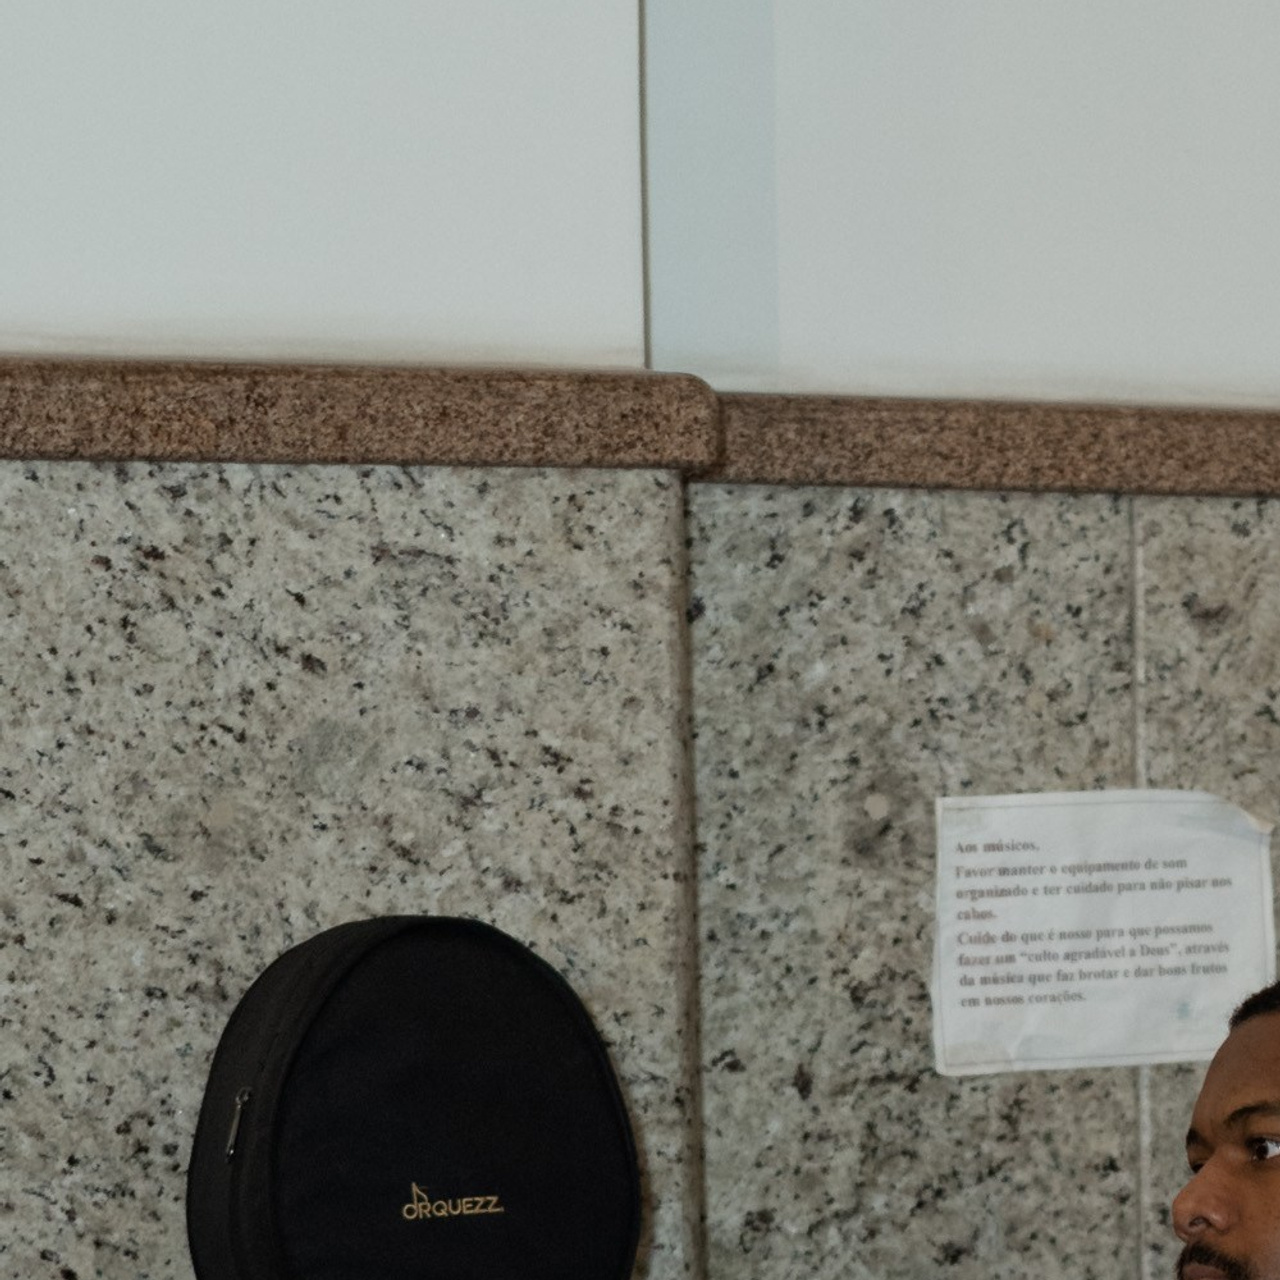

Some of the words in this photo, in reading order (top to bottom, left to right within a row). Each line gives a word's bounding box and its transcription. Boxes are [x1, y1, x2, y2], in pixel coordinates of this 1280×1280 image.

[955, 866, 995, 879] Favor
[998, 865, 1046, 876] manter
[1049, 865, 1057, 874] o
[1061, 860, 1140, 876] equipamento
[1144, 858, 1158, 870] de
[1162, 859, 1187, 869] som
[956, 885, 1028, 902] organizado
[1043, 885, 1062, 895] ter
[1066, 881, 1113, 894] cuidado
[1117, 882, 1146, 895] para
[1150, 878, 1172, 890] não
[1176, 878, 1208, 892] pisar
[1211, 878, 1232, 888] nos
[957, 931, 996, 945] Cuide
[1000, 930, 1017, 942] do
[1020, 931, 1044, 945] que
[1059, 930, 1092, 940] nosso
[1096, 928, 1124, 942] para
[1128, 926, 1151, 940] que
[1154, 924, 1213, 938] possamos
[957, 953, 991, 966] fazer
[994, 953, 1016, 964] um
[1185, 940, 1230, 955] através
[959, 974, 975, 987] da
[980, 972, 1024, 986] música
[1028, 973, 1053, 988] que
[1056, 968, 1075, 982] faz
[1078, 968, 1119, 980] brotar
[1134, 965, 1155, 978] dar
[1158, 964, 1187, 976] bons
[1190, 962, 1228, 975] frutos
[960, 997, 980, 1008] em
[984, 995, 1025, 1006] nossos
[402, 1182, 505, 1220] ORQUEZZ
